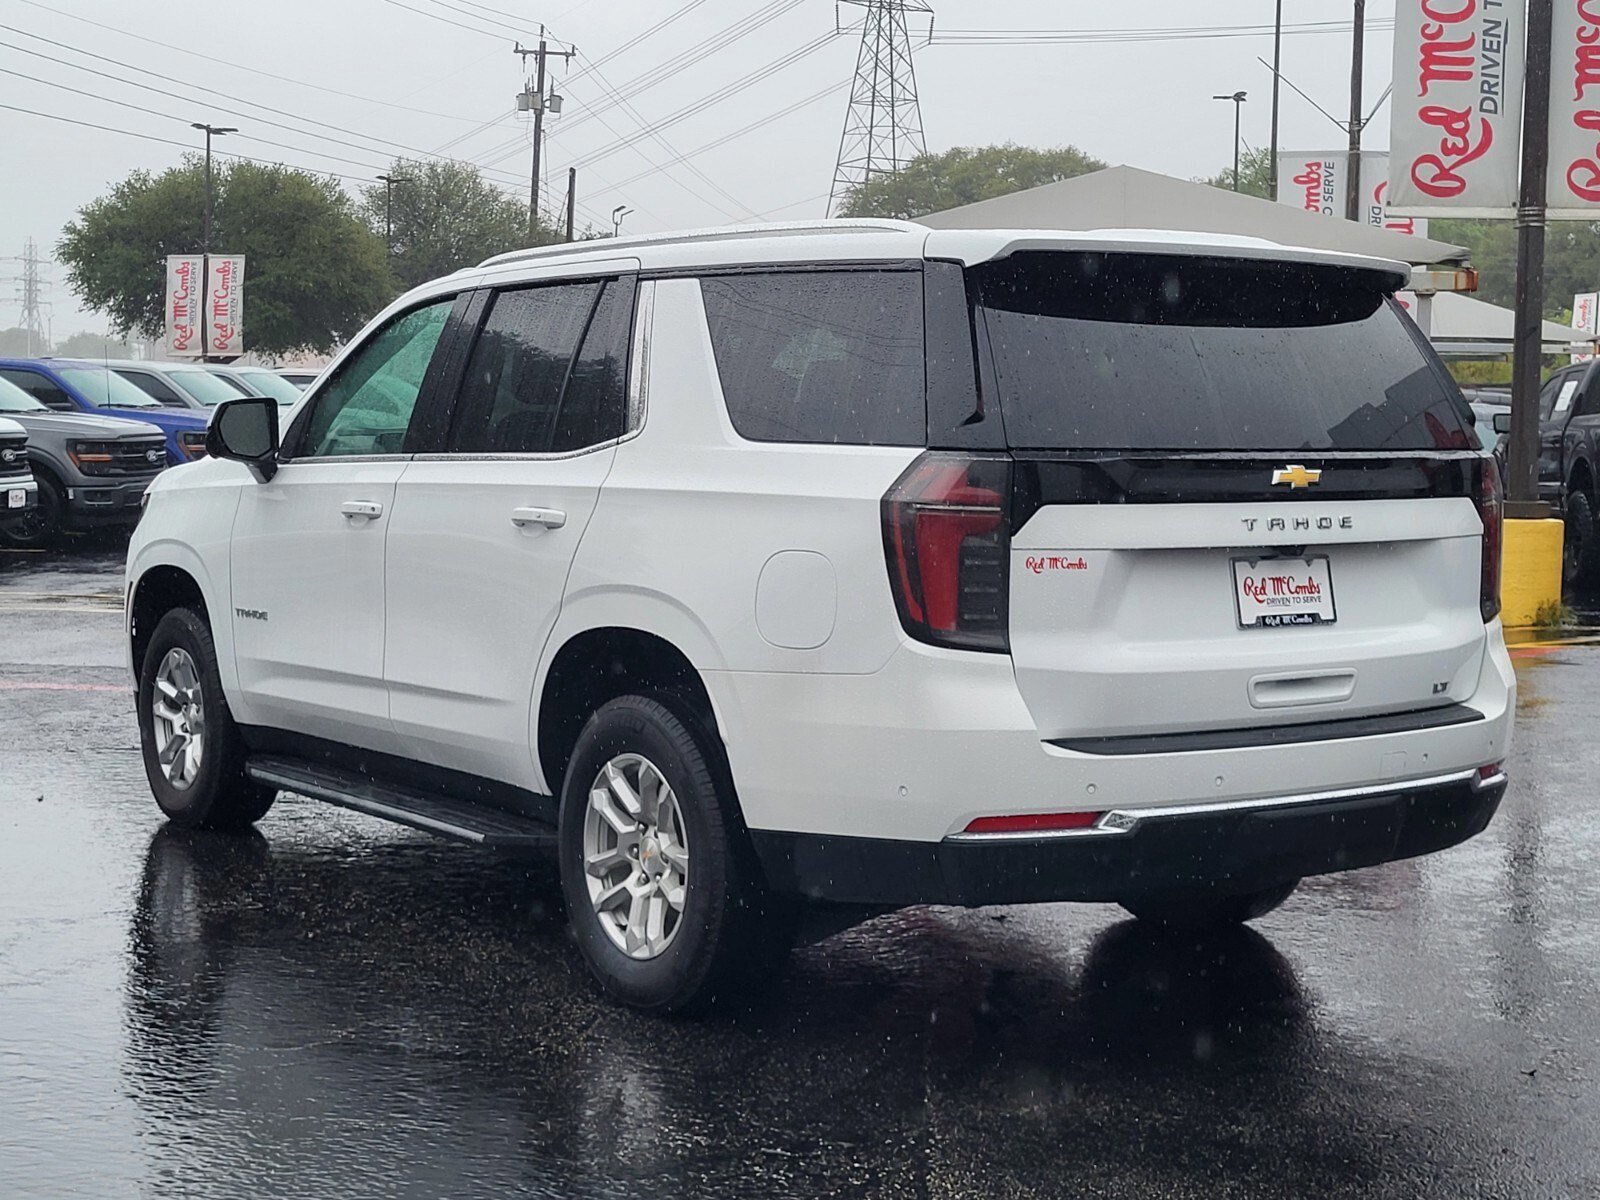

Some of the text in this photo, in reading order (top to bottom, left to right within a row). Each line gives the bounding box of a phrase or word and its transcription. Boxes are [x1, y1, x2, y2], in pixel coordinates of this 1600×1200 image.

[1479, 0, 1503, 115] DRIVEN T
[1411, 106, 1493, 198] Red
[1323, 161, 1335, 203] SERVE
[190, 286, 196, 296] TO
[231, 285, 237, 295] TO
[173, 323, 193, 350] Red
[213, 323, 234, 350] Red
[1241, 516, 1353, 532] TAHOE
[1025, 556, 1088, 574] Red McCombs
[1243, 575, 1321, 604] Red McCombs
[1266, 595, 1322, 606] DRIVEN TO SERVE
[235, 607, 269, 621] TAHOE
[1432, 681, 1450, 695] LT
